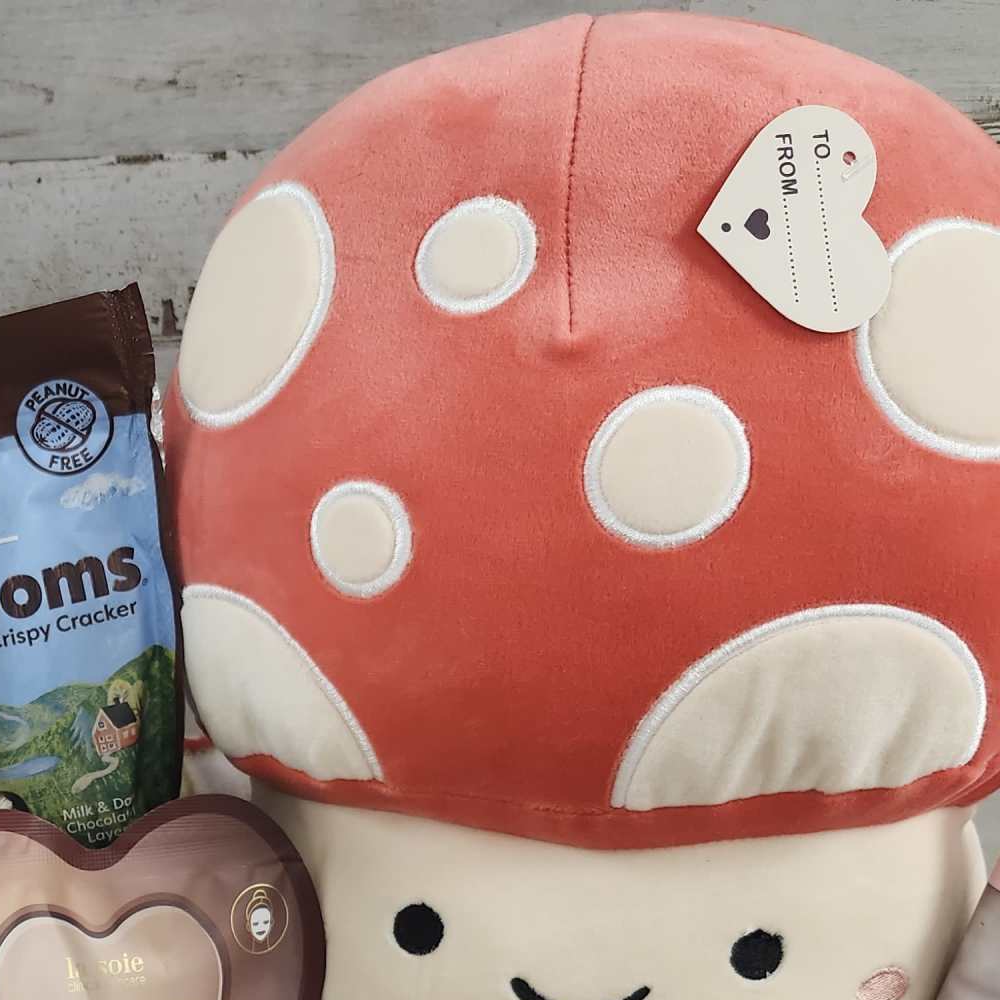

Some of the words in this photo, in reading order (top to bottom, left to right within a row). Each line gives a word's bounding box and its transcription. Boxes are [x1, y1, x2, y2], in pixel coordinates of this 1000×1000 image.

[812, 129, 831, 160] TO
[775, 133, 799, 196] FROM
[24, 382, 90, 412] PEANUT
[48, 447, 94, 471] FREE
[55, 599, 138, 633] Cracker
[62, 804, 94, 821] Milk
[97, 801, 110, 813] &
